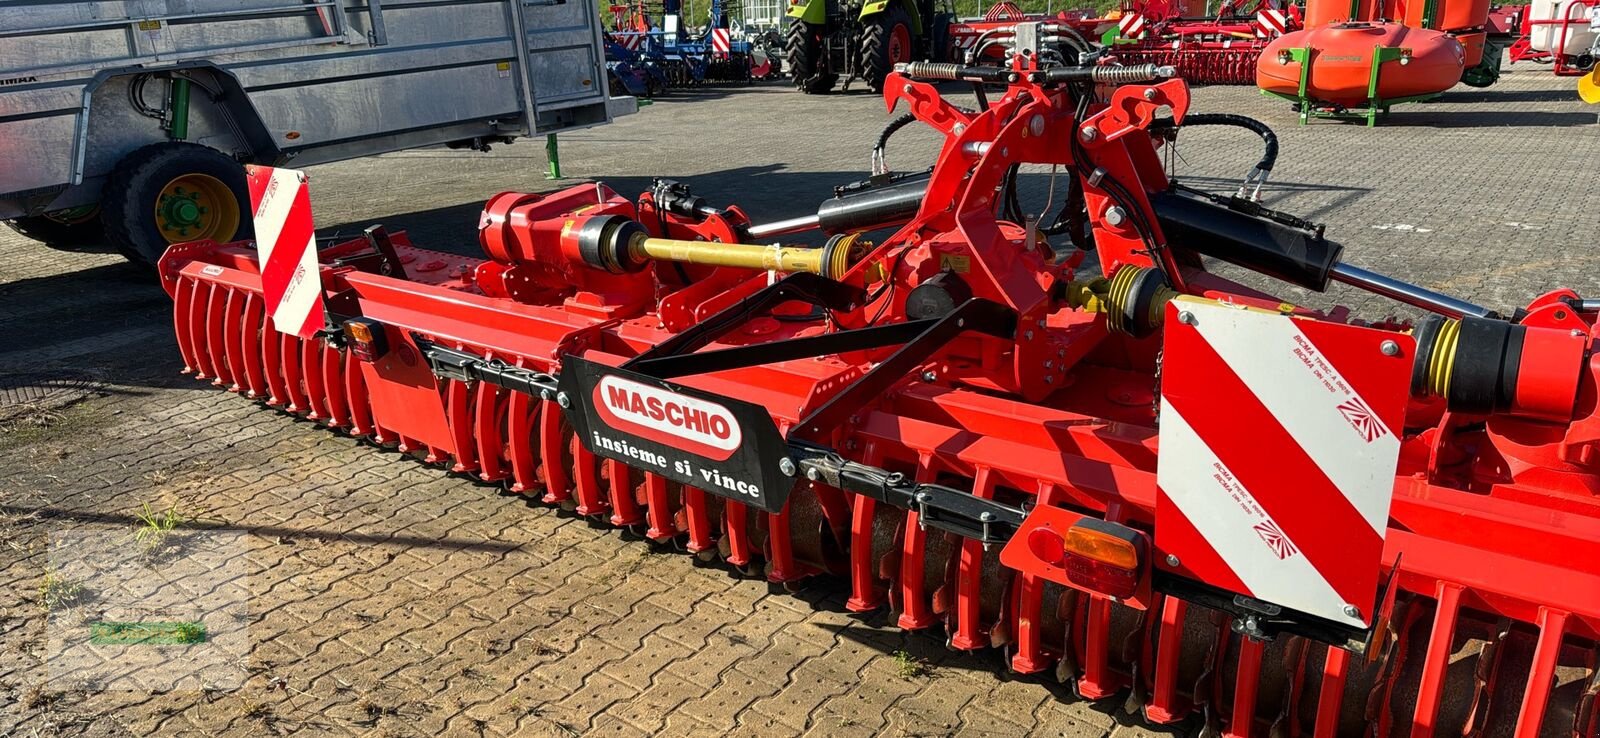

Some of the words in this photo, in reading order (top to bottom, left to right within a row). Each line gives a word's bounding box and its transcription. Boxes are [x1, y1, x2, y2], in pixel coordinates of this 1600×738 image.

[1293, 335, 1314, 356] BICMA
[1293, 348, 1314, 369] BICMA
[607, 384, 731, 440] MASCHIO
[593, 431, 667, 468] insieme
[674, 460, 693, 477] si
[700, 468, 760, 498] vince
[1213, 462, 1232, 481] BICMA
[1213, 473, 1232, 493] BICMA
